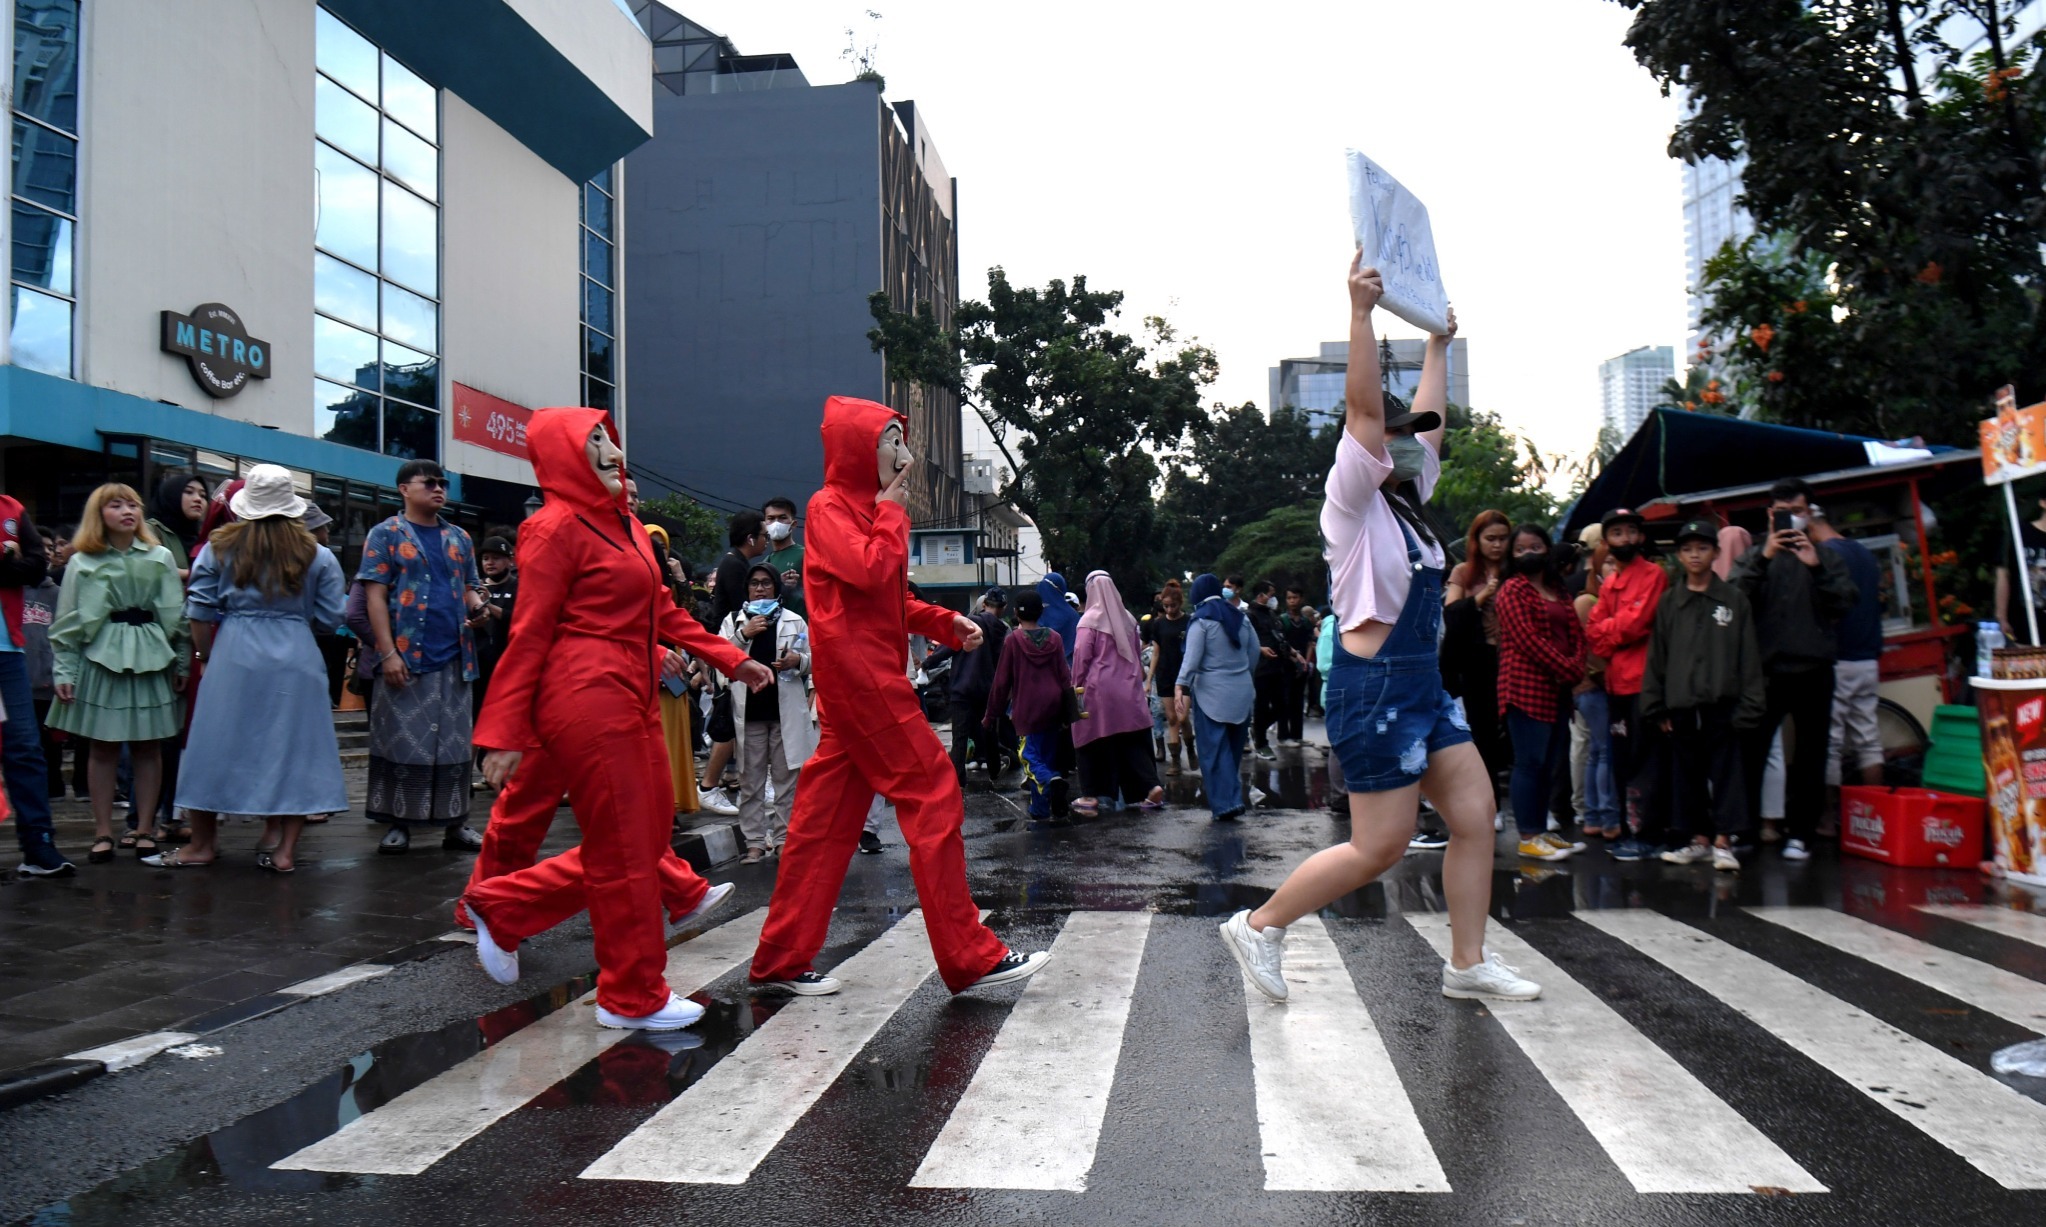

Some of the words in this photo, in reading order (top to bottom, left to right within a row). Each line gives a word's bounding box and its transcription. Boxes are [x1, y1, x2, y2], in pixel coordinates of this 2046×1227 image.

[176, 321, 264, 369] METRO
[221, 380, 234, 389] Bar
[486, 411, 515, 443] 495
